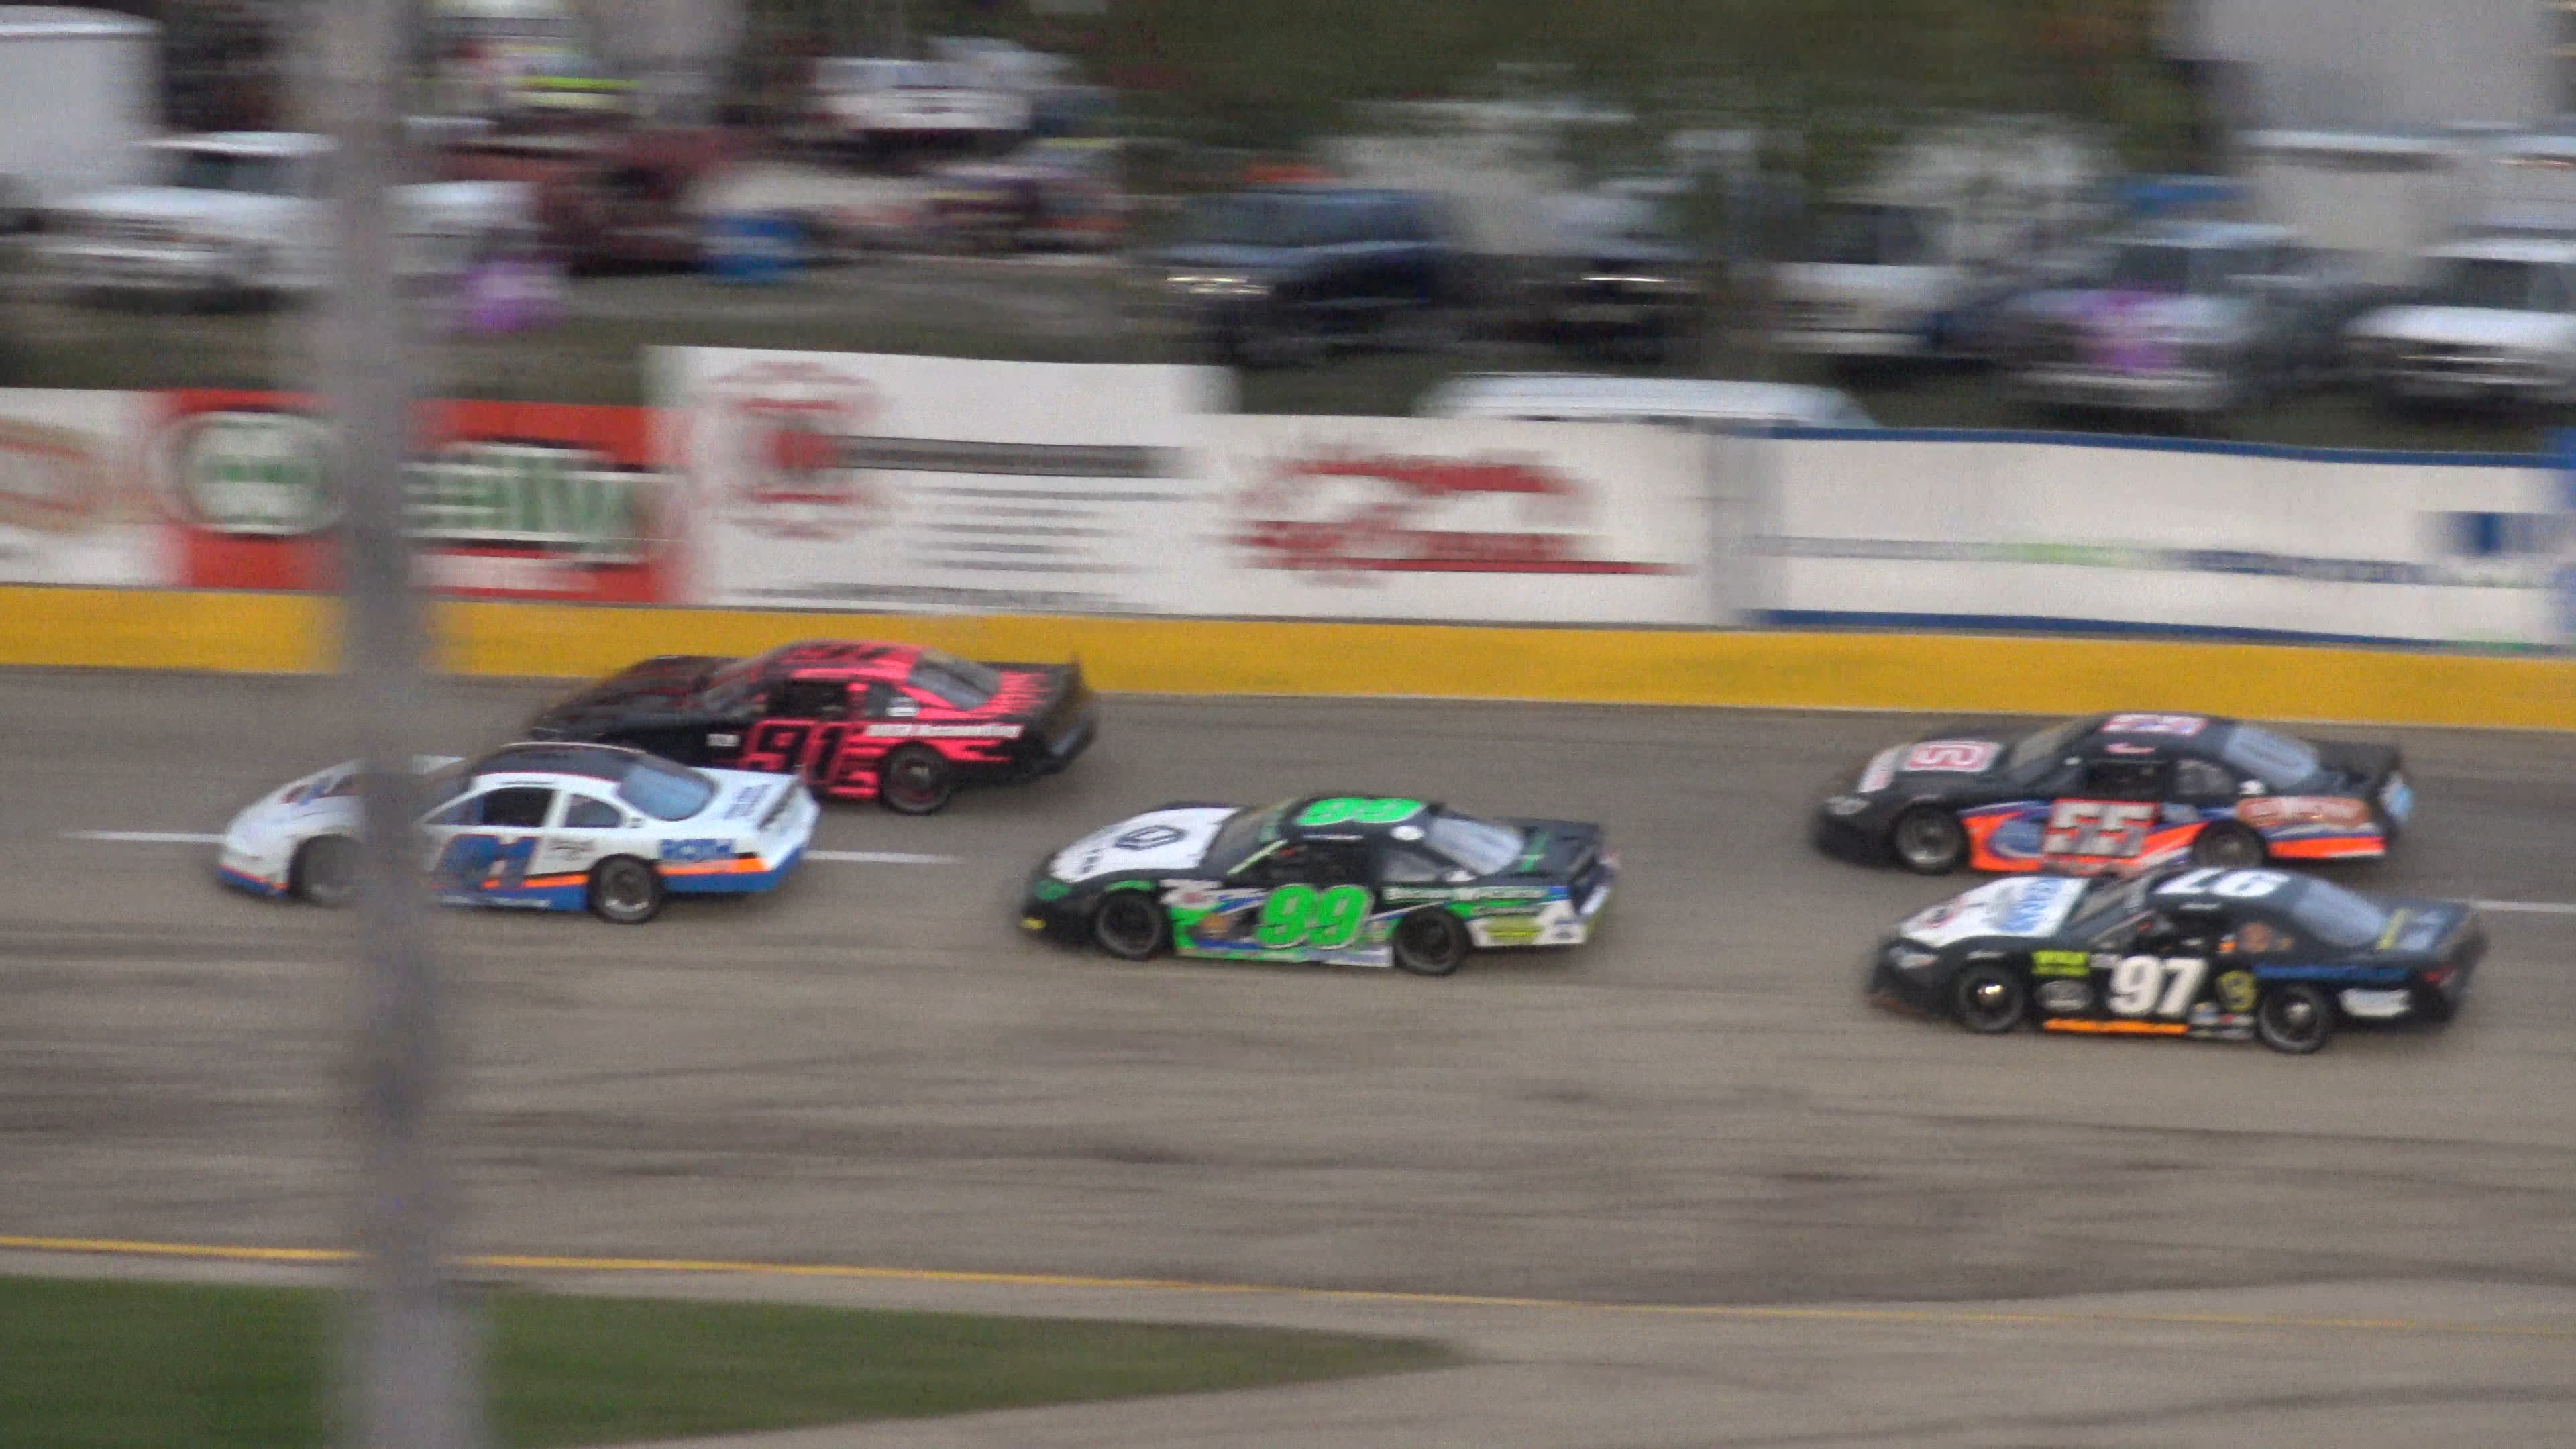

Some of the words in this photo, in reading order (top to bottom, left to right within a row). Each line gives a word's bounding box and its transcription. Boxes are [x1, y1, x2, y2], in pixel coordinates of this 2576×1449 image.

[1296, 797, 1425, 826] 99
[2045, 800, 2157, 857] 55
[1256, 883, 1373, 949] 99
[2108, 955, 2210, 1016] 97
